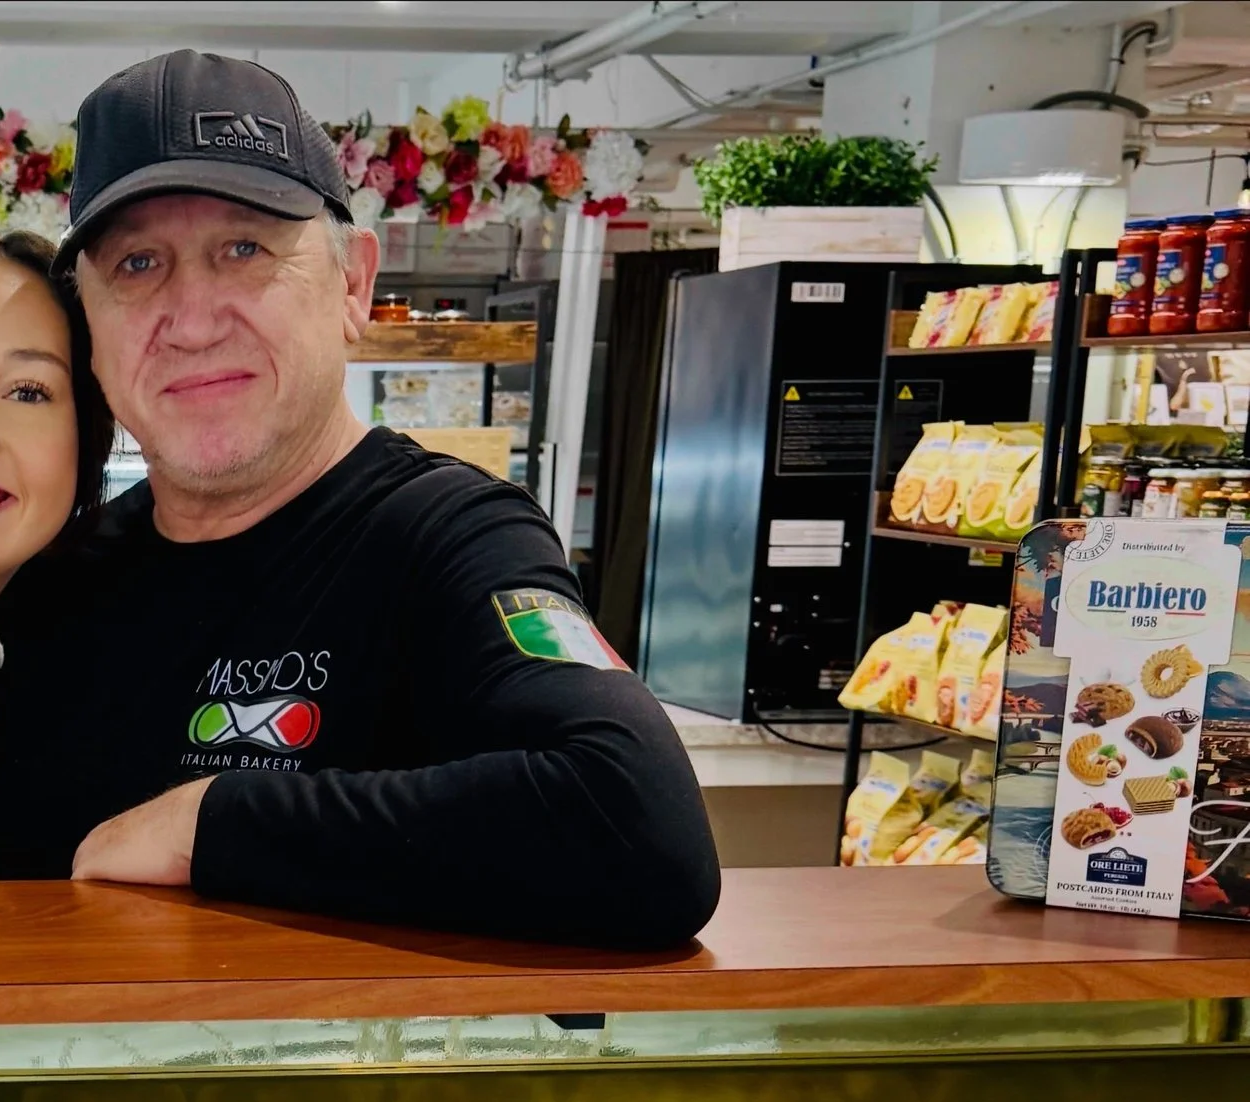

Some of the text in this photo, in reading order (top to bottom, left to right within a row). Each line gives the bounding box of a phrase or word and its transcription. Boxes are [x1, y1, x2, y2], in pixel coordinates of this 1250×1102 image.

[214, 133, 275, 155] adidas
[1087, 579, 1207, 611] Barbiero
[1130, 614, 1158, 628] 1958
[180, 753, 302, 772] ITALIAN BAKERY
[1090, 860, 1143, 873] ORE LIETE
[1056, 882, 1175, 901] POSTCARDS FROM ITALY
